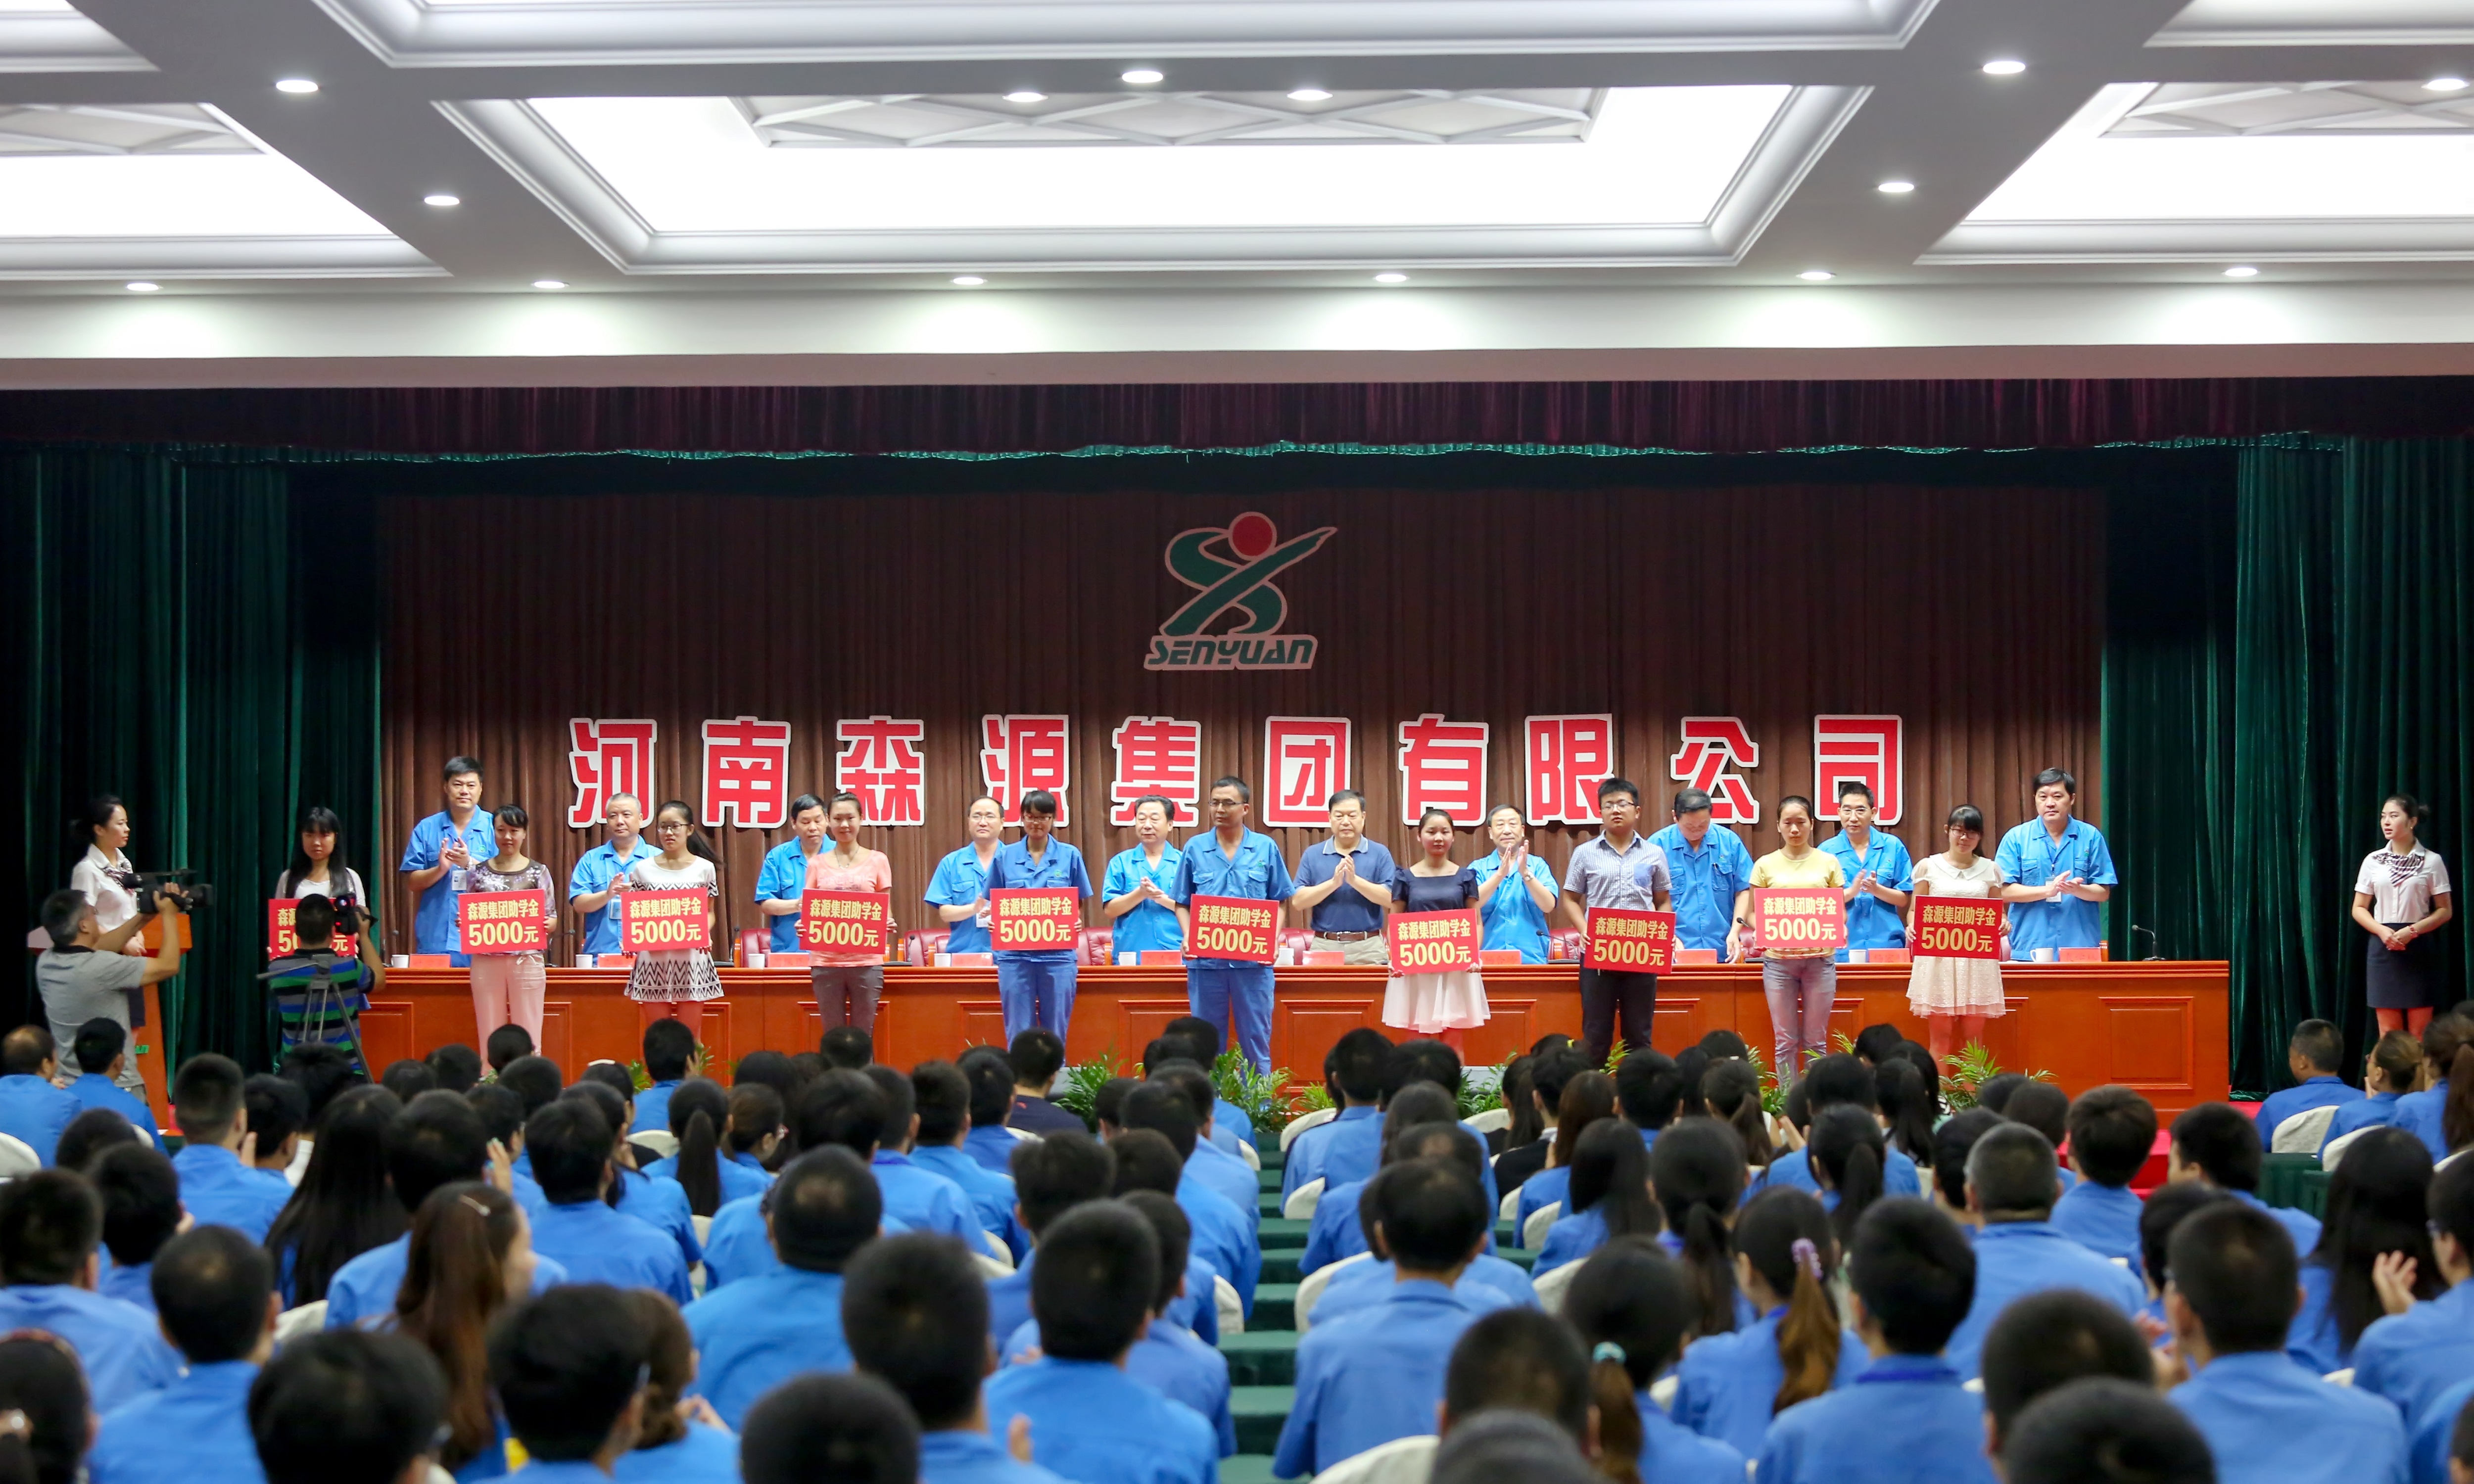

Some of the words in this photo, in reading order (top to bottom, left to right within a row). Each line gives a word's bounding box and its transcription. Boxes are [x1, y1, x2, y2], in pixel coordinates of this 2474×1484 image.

[1146, 638, 1315, 666] SENYUAN
[569, 714, 1903, 829] 河南森源集团有限公司
[467, 898, 539, 921] 森源集团助学金
[629, 896, 702, 919] 森源集团助学金
[809, 898, 883, 921] 森源集团助学金
[999, 896, 1073, 917] 森源集团助学金
[1198, 904, 1272, 928] 森源集团助学金
[1763, 896, 1837, 916] 森源集团助学金
[1922, 905, 1996, 926] 森源集团助学金
[468, 921, 539, 947] 5000元
[630, 919, 702, 944] 5000元
[808, 920, 879, 947] 5000元
[999, 918, 1072, 943] 5000元
[1196, 926, 1268, 955] 5000元
[1397, 918, 1472, 941] 森源集团助学金
[1595, 917, 1668, 940] 森源集团助学金
[1764, 918, 1837, 941] 5000元
[1921, 927, 1993, 952] 5000元
[1399, 940, 1472, 967] 5000元
[1593, 939, 1665, 966] 5000元
